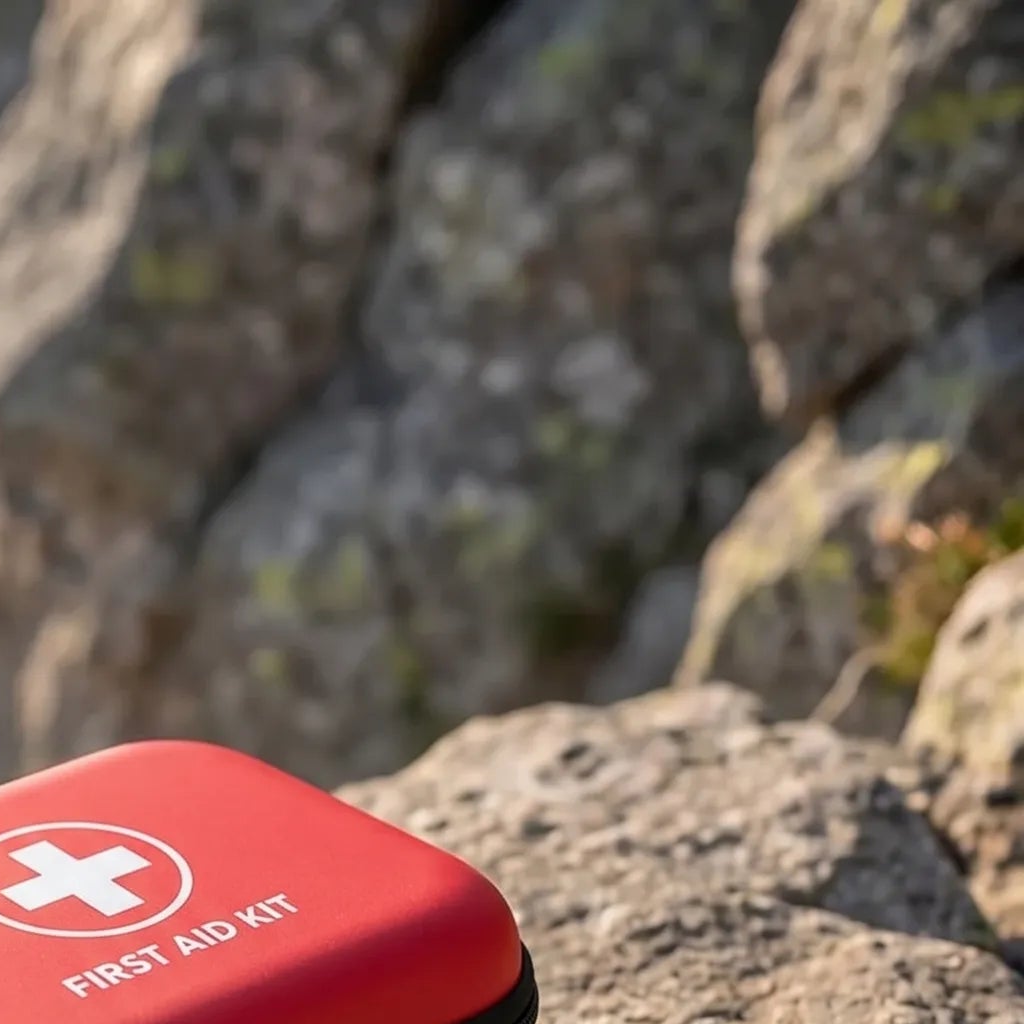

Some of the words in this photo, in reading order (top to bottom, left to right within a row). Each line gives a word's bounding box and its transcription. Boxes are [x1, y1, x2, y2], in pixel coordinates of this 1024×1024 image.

[61, 943, 170, 999] FIRST
[172, 920, 238, 957] AID
[233, 892, 299, 929] KIT
